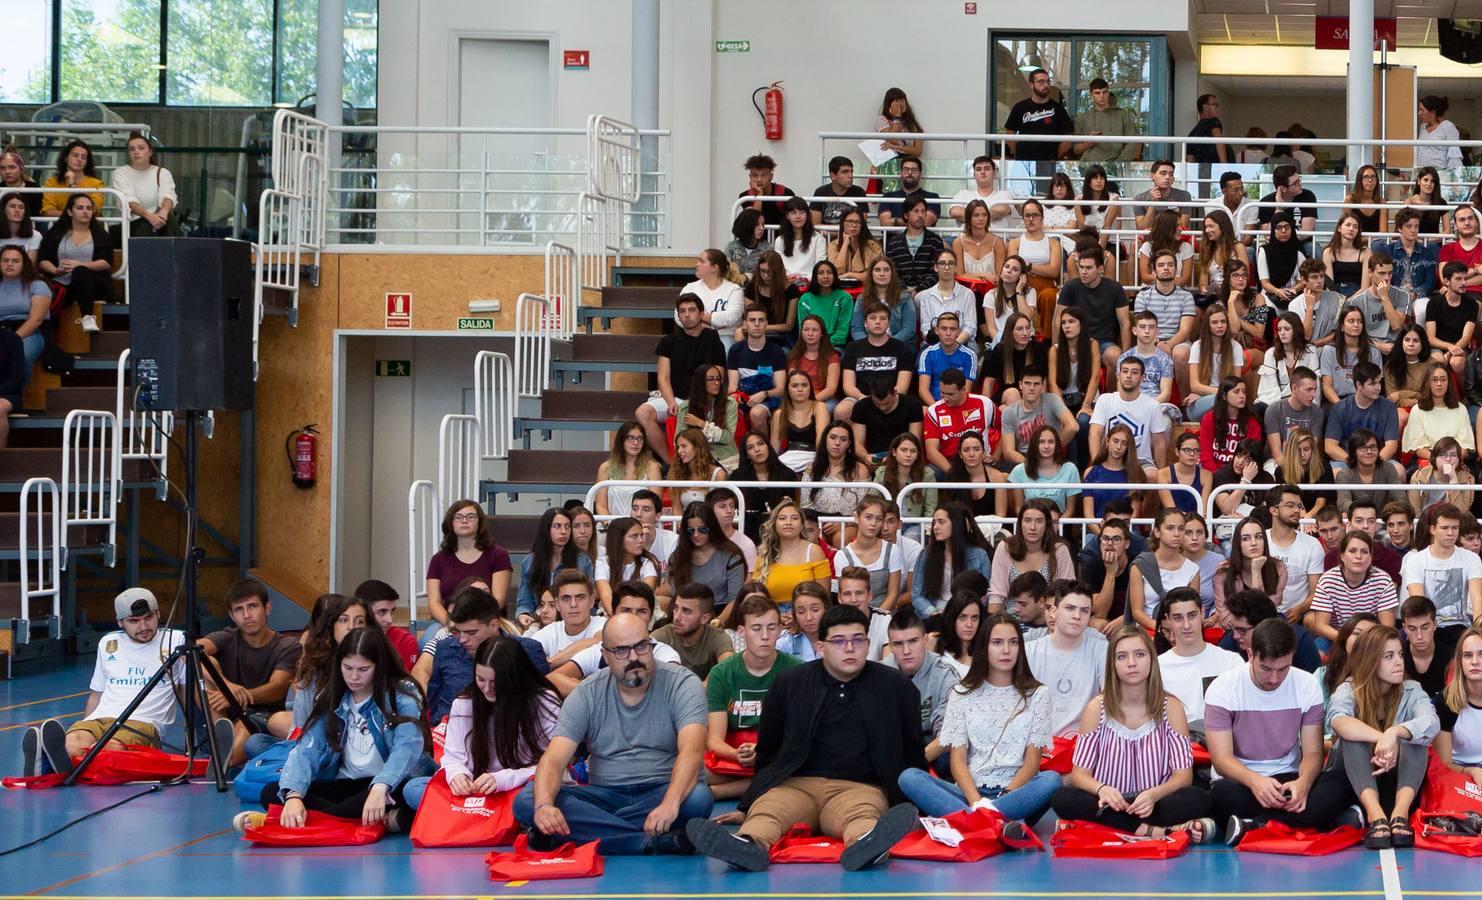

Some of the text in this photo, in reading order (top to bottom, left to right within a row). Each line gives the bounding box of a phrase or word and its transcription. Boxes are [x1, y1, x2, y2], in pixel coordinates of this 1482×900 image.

[460, 319, 492, 329] SALIDA
[860, 359, 893, 368] adidas
[128, 667, 146, 676] Fly
